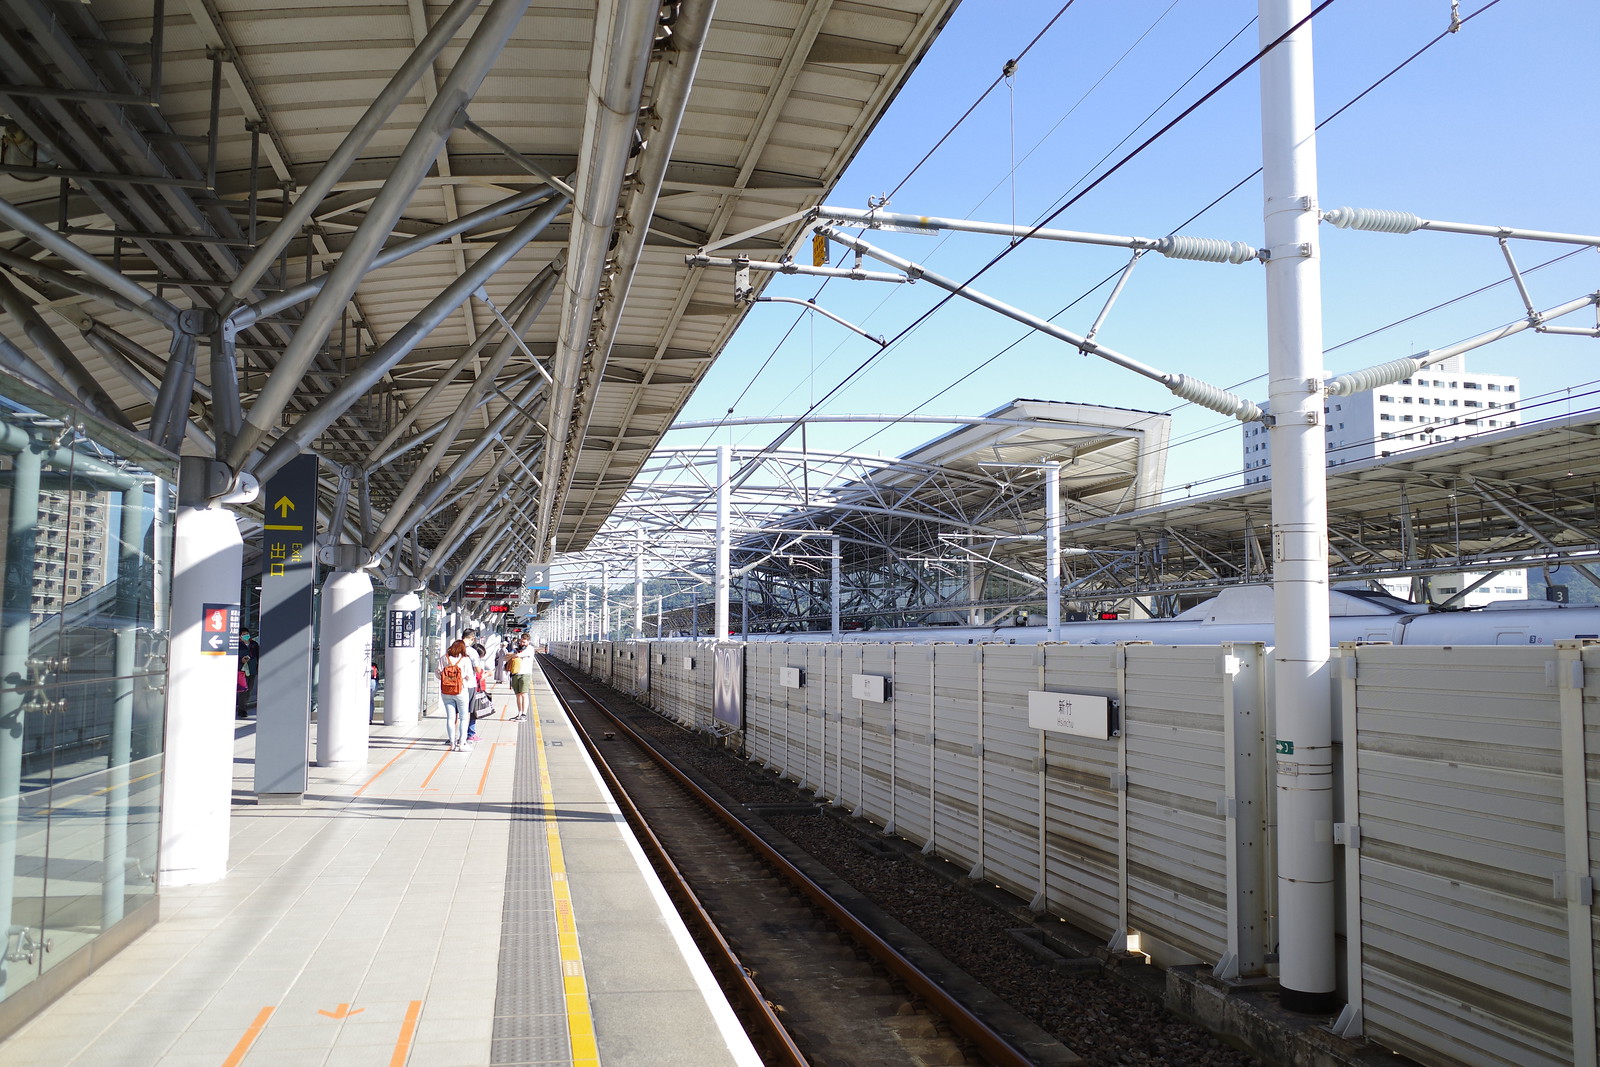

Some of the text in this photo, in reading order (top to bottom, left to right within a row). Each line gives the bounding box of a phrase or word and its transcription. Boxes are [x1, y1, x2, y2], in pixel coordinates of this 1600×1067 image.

[270, 542, 286, 577] 出口
[291, 542, 303, 562] Exit
[534, 571, 544, 584] 3
[1556, 591, 1563, 602] 3
[1058, 699, 1073, 715] 新竹
